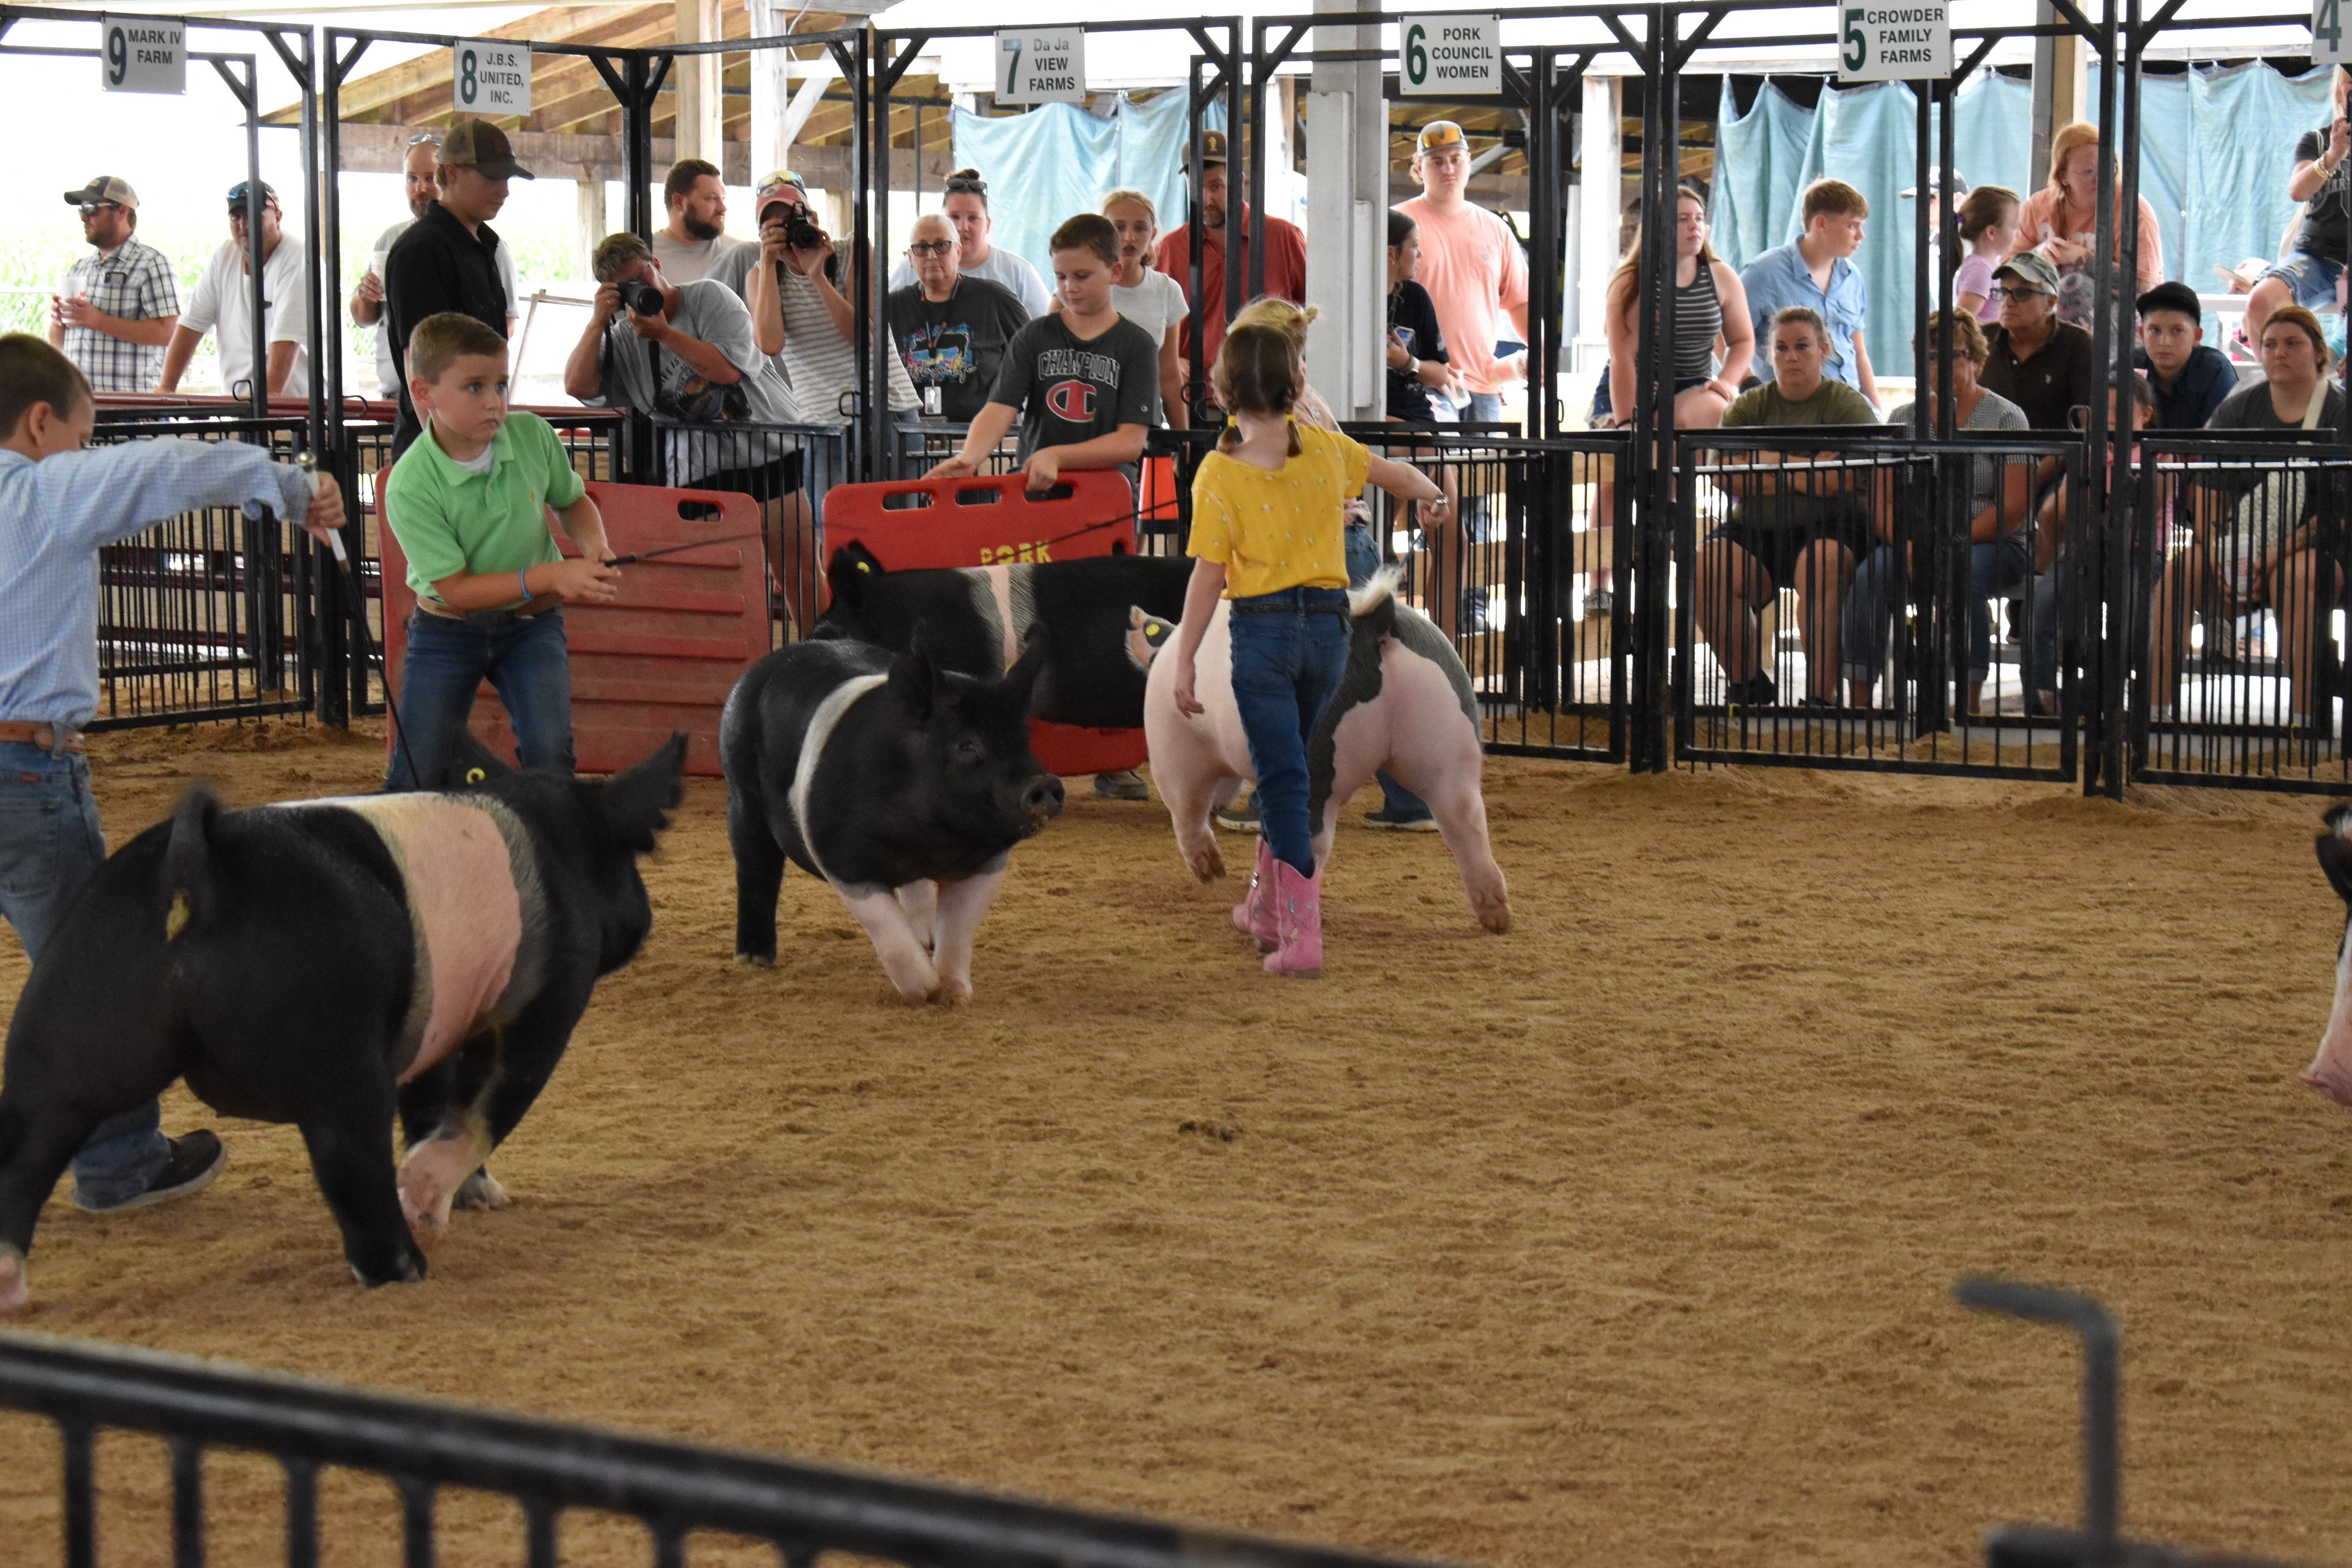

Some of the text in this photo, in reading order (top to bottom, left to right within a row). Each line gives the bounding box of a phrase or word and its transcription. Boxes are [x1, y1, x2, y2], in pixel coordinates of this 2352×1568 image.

[1867, 8, 1944, 24] CROWDER
[128, 29, 181, 45] MARK IV
[1443, 28, 1481, 40] PORK
[1843, 9, 1866, 72] 5
[1880, 28, 1932, 43] FAMILY
[1034, 37, 1069, 51] Da Ja
[108, 26, 127, 86] 9
[137, 49, 173, 64] FARM
[486, 53, 518, 67] J.B.S.
[1406, 24, 1427, 85] 6
[1431, 47, 1493, 59] COUNCIL
[1880, 48, 1932, 63] FARMS
[1003, 39, 1022, 94] 7
[1035, 57, 1068, 71] VIEW
[1436, 65, 1489, 78] WOMEN
[461, 49, 477, 105] 8
[480, 70, 524, 88] UNITED,
[1029, 76, 1075, 91] FARMS
[491, 89, 513, 104] INC.
[1038, 348, 1121, 390] CHAMPION
[980, 541, 1052, 565] PORK
